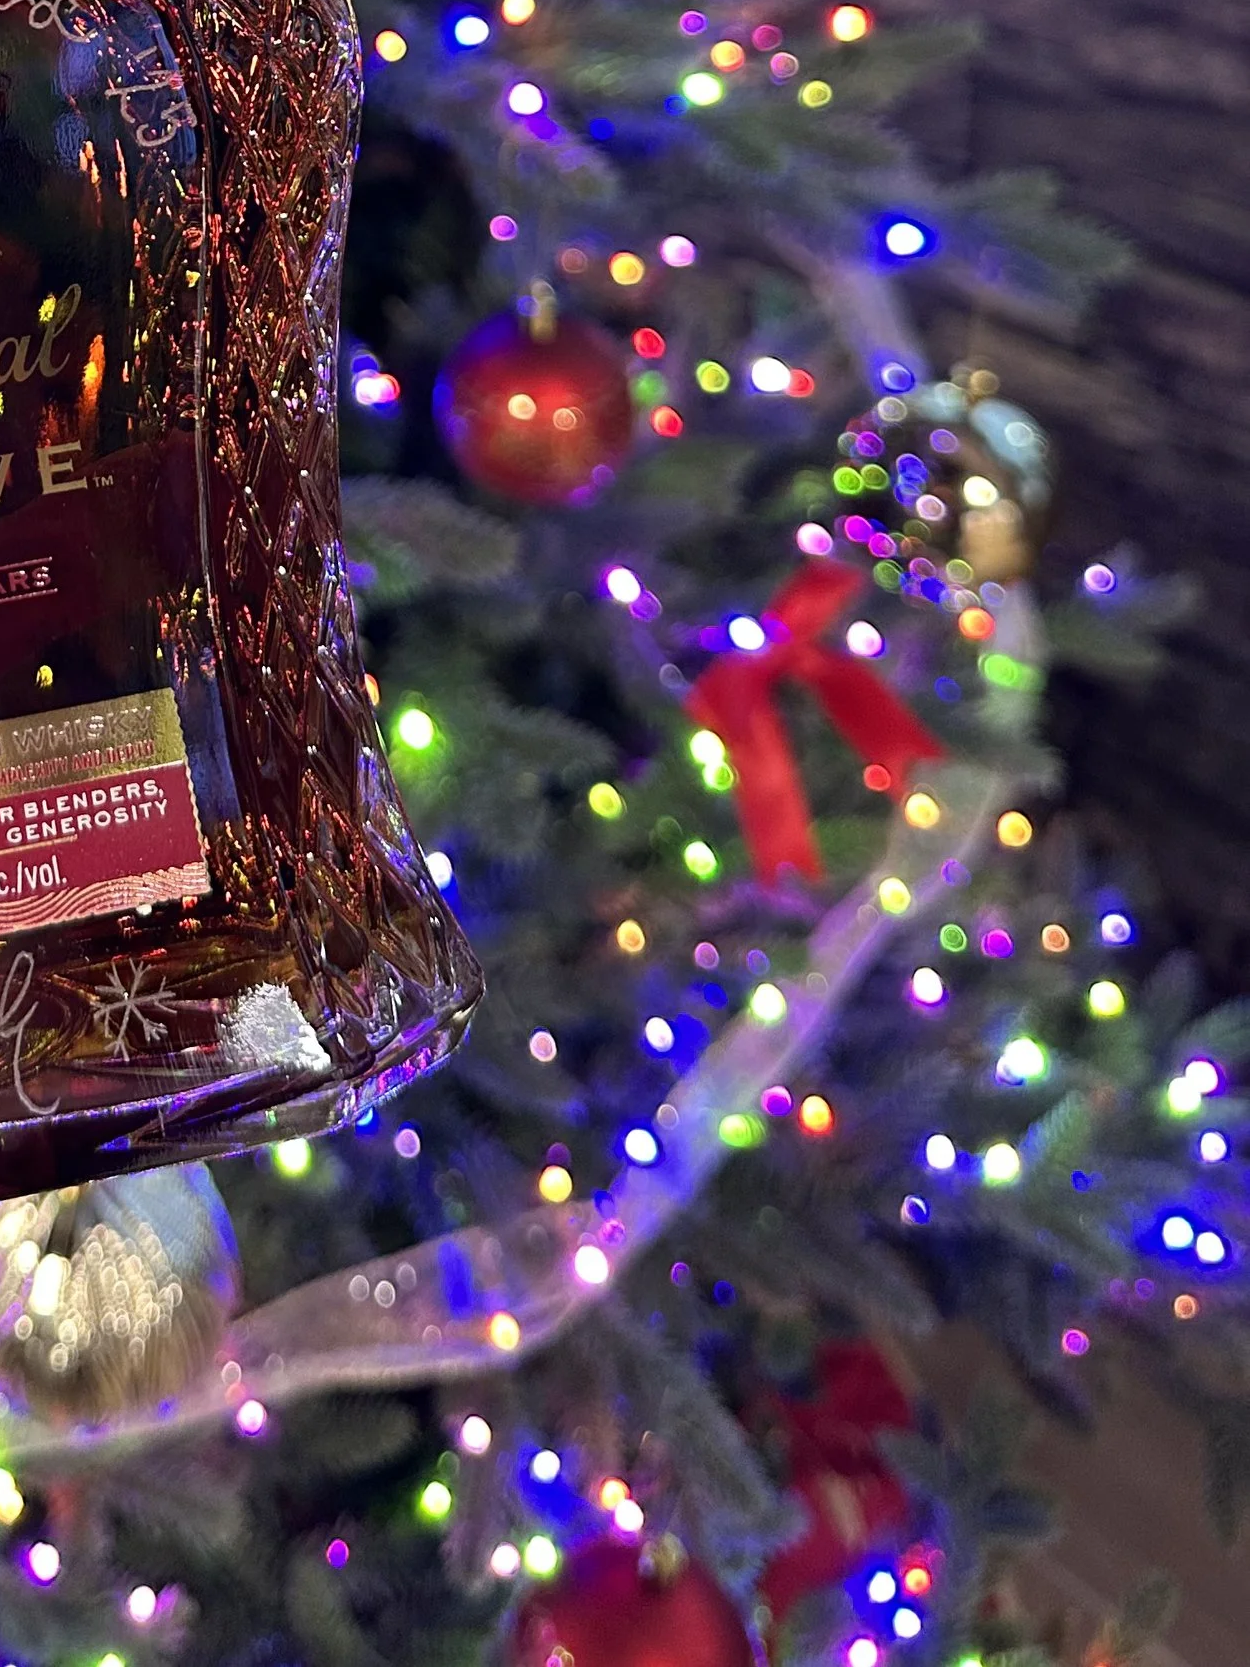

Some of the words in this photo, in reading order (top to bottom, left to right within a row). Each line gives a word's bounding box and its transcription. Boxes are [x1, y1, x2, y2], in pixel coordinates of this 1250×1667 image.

[12, 705, 153, 754] WHISKY
[72, 747, 103, 771] AND
[23, 779, 165, 819] BLENDERS,
[5, 798, 169, 845] GENEROSITY
